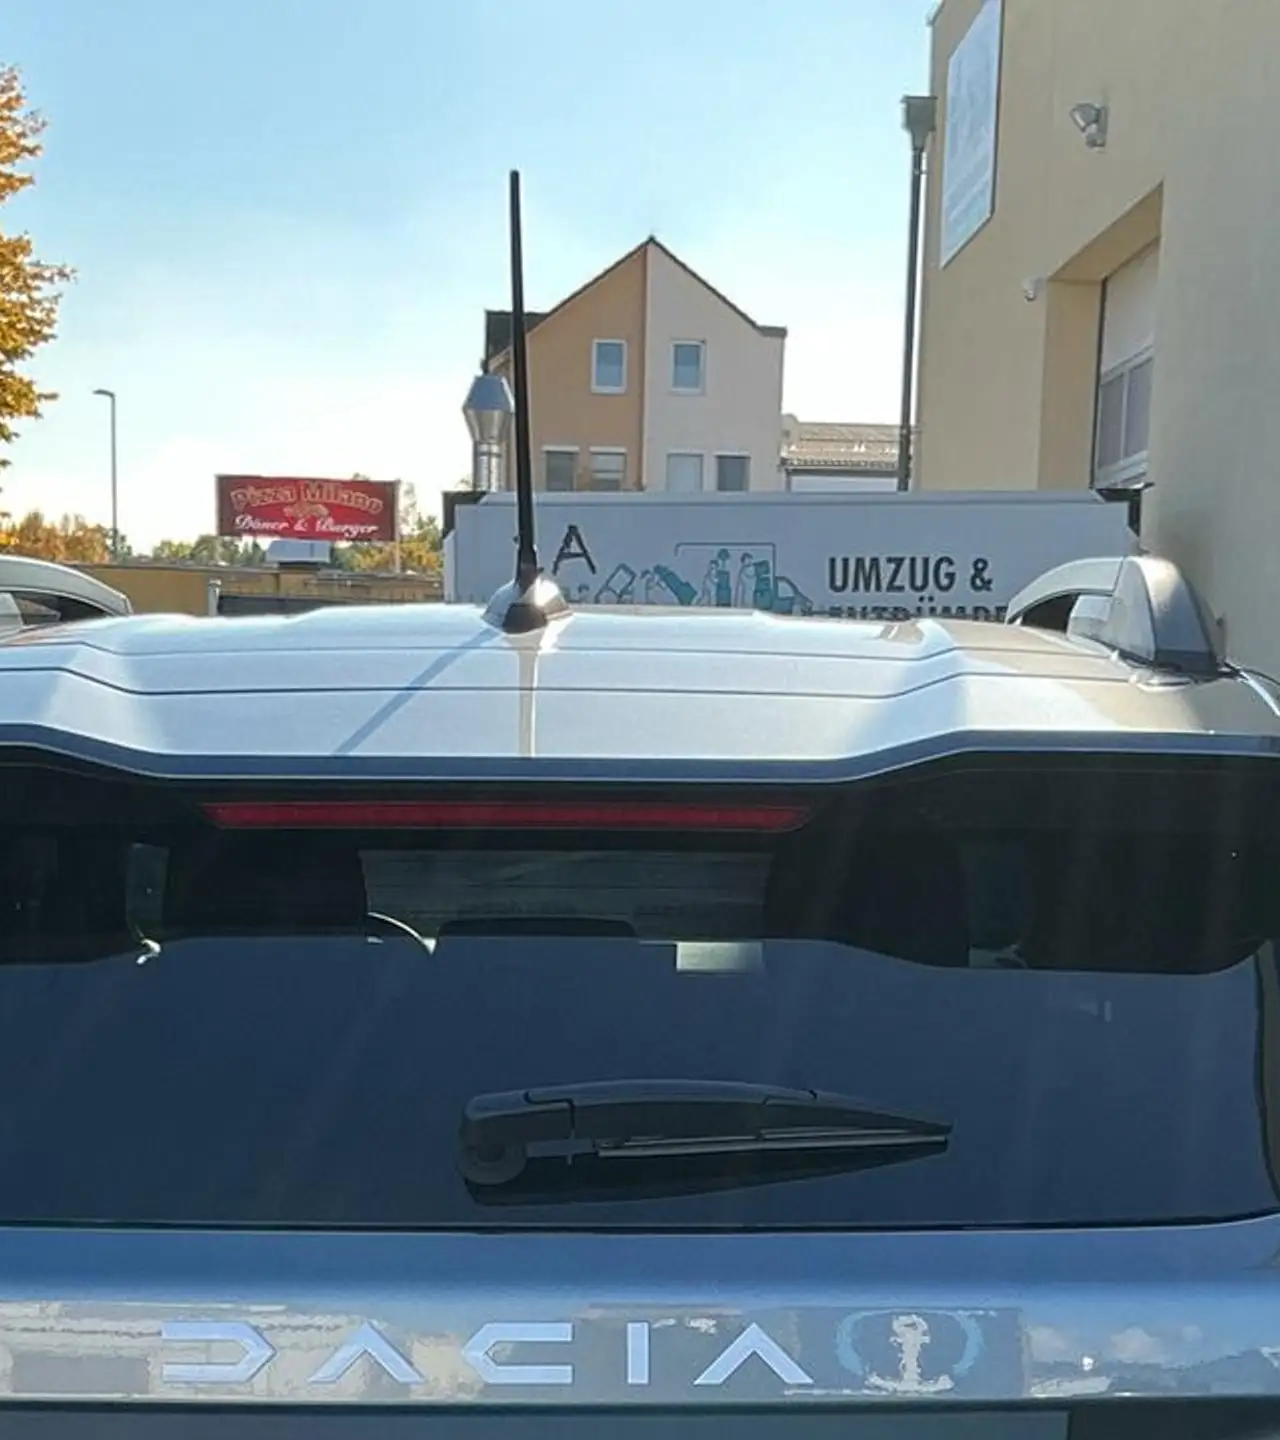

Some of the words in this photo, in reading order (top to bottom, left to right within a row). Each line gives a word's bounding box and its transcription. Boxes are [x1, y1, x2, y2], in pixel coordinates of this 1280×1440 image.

[828, 556, 956, 593] UMZUG
[970, 557, 993, 592] &
[162, 1320, 814, 1386] DACIA
